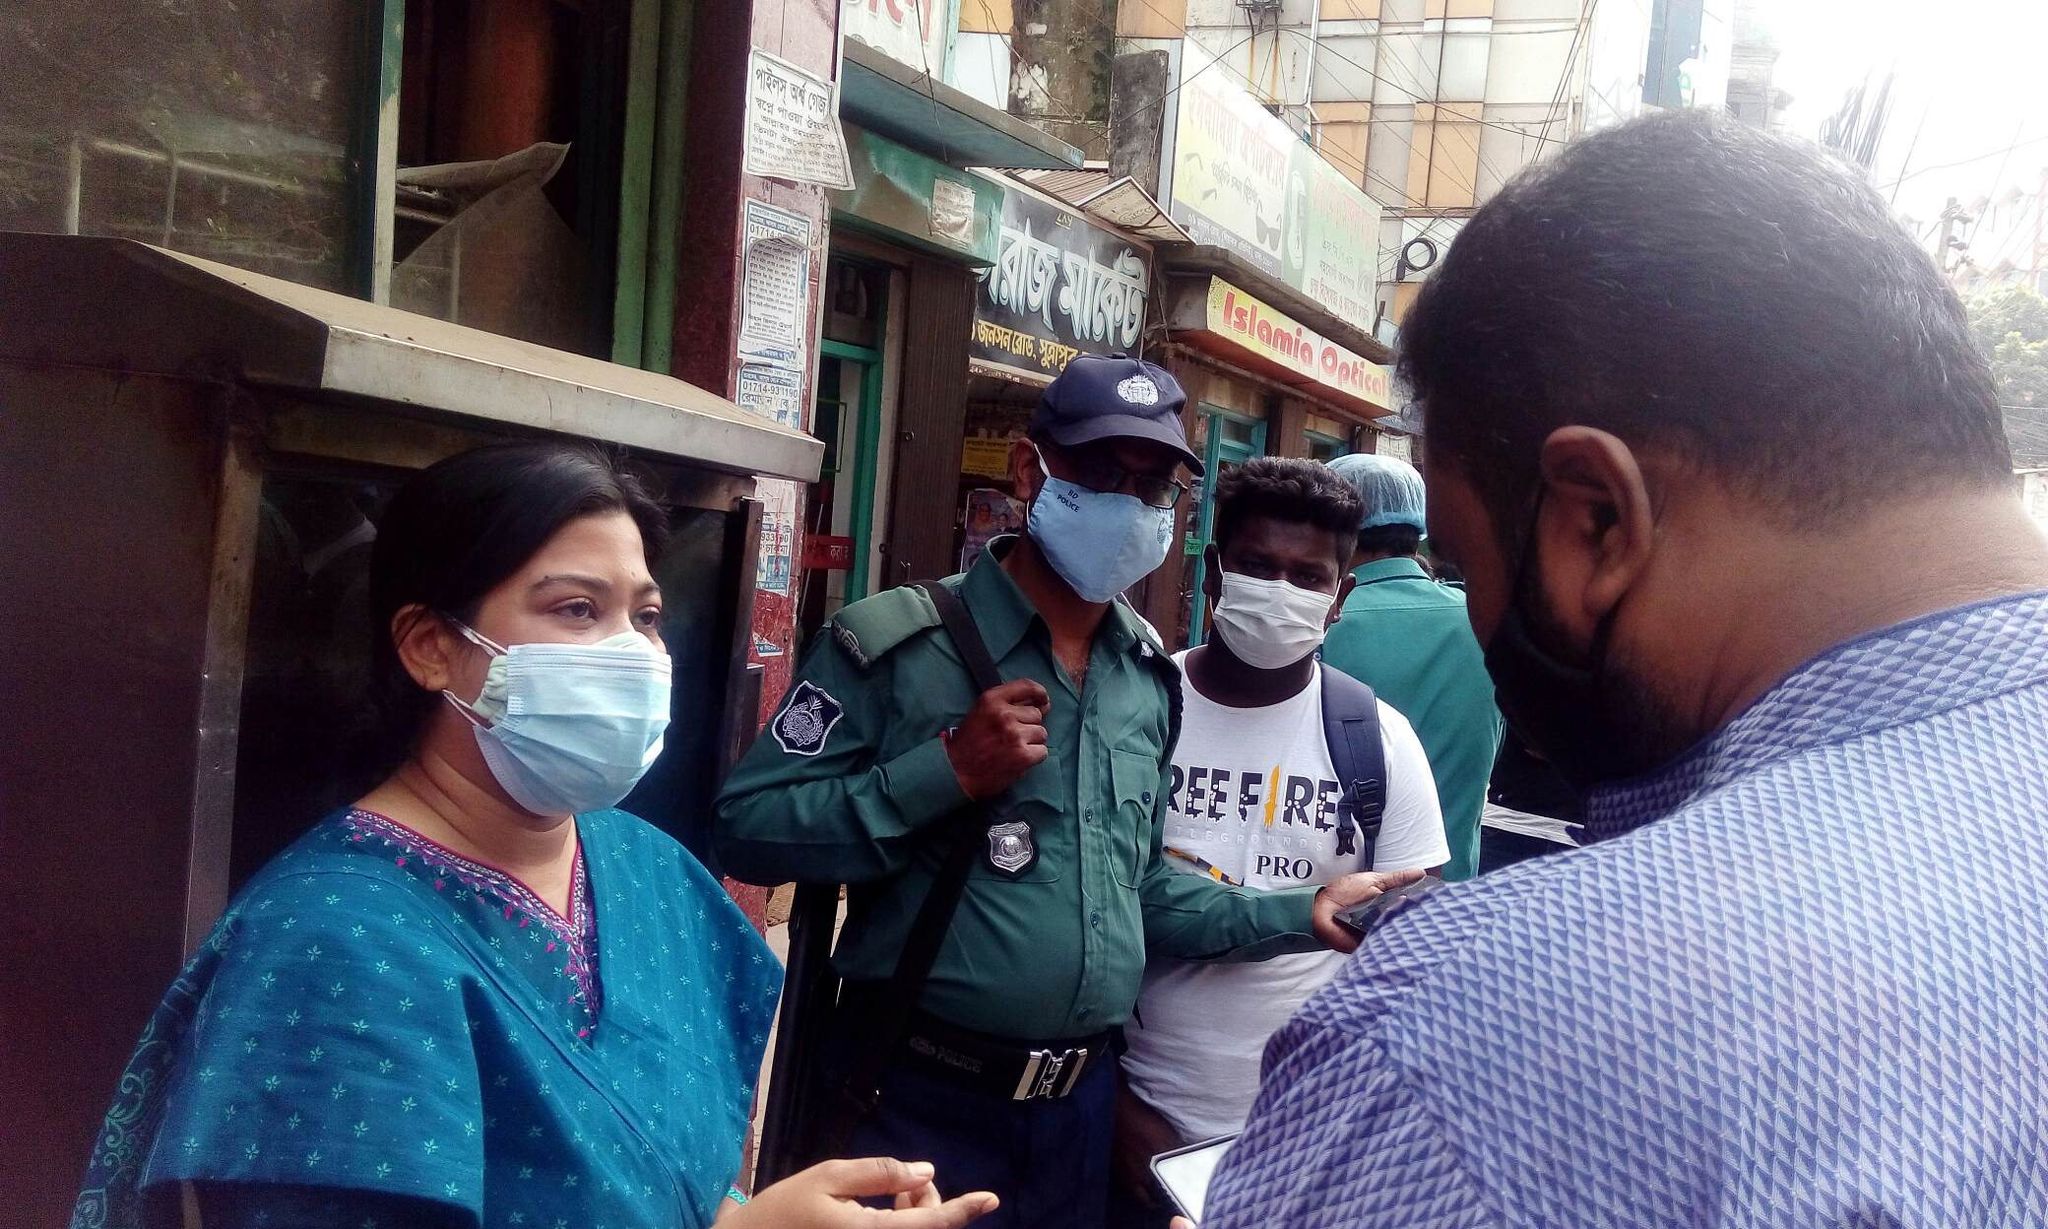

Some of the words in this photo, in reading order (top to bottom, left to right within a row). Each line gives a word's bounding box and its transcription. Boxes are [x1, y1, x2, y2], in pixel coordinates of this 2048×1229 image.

[977, 319, 1013, 352] জনসন
[1222, 290, 1315, 368] Islamia
[1320, 345, 1388, 398] Optical
[1056, 494, 1081, 513] POLICE
[1067, 489, 1079, 499] BD
[1254, 854, 1314, 880] PRO
